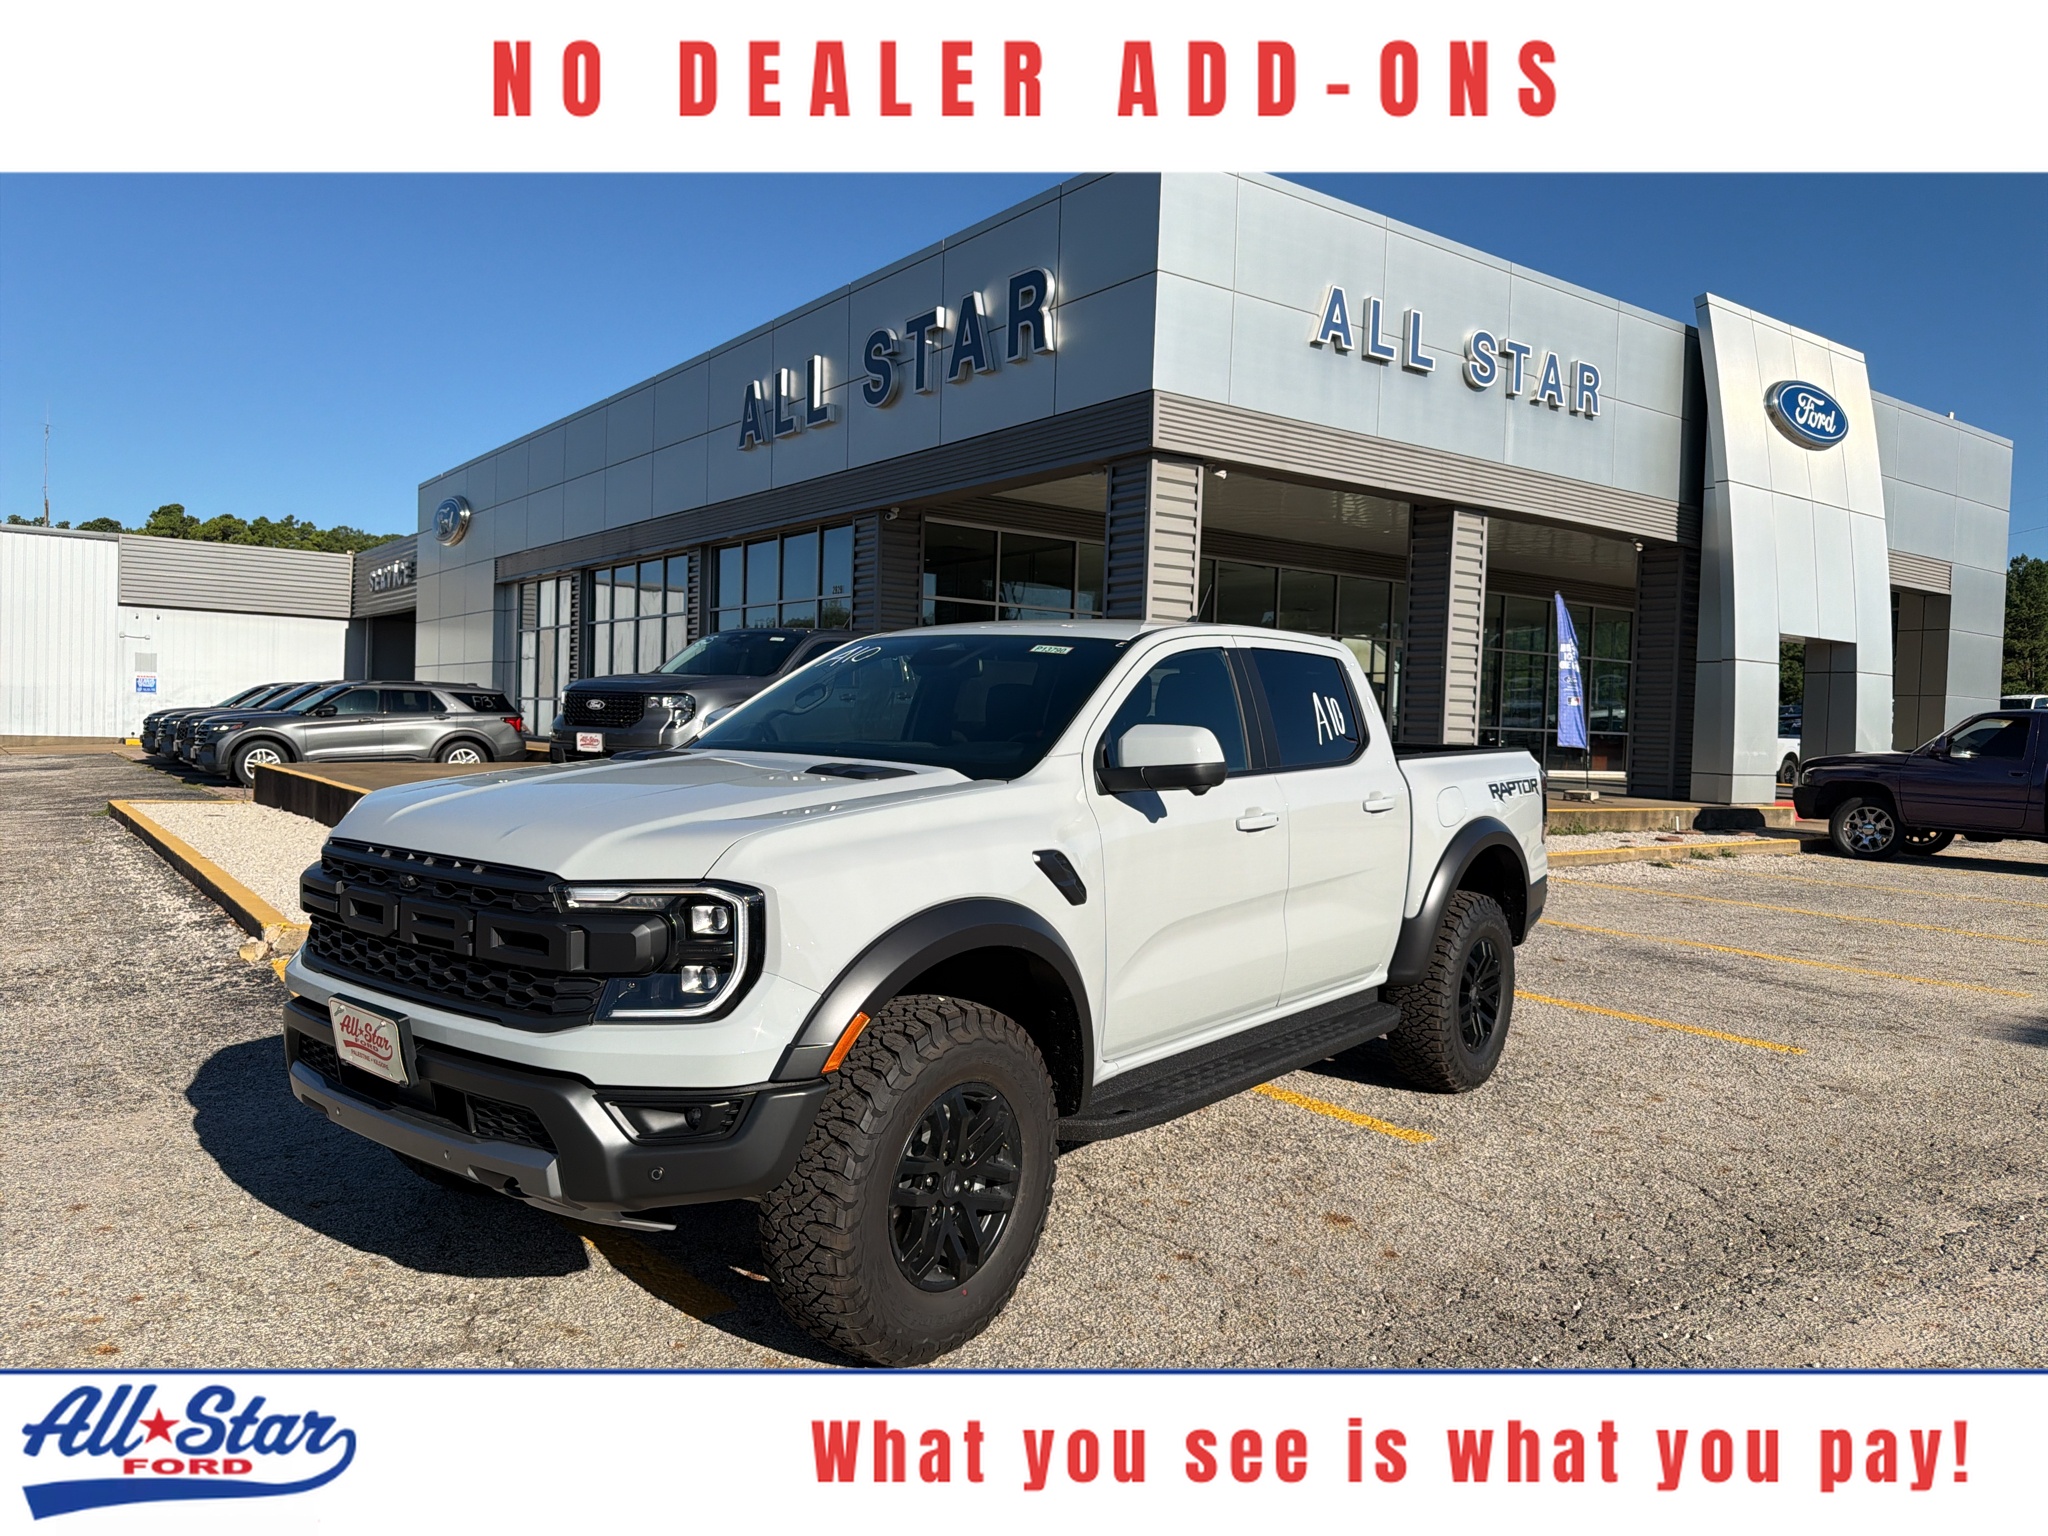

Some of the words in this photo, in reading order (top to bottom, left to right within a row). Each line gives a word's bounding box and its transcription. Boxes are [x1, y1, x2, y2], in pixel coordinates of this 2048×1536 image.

[738, 355, 836, 451] ALL
[862, 266, 1056, 408] STAR
[1311, 284, 1435, 376] ALL
[1463, 329, 1600, 416] STAR
[1795, 393, 1836, 433] Ford
[815, 646, 881, 667] A10
[1488, 778, 1541, 804] RAPTOR
[340, 1014, 360, 1037] All
[364, 1022, 393, 1050] Star
[355, 1037, 379, 1052] FORD
